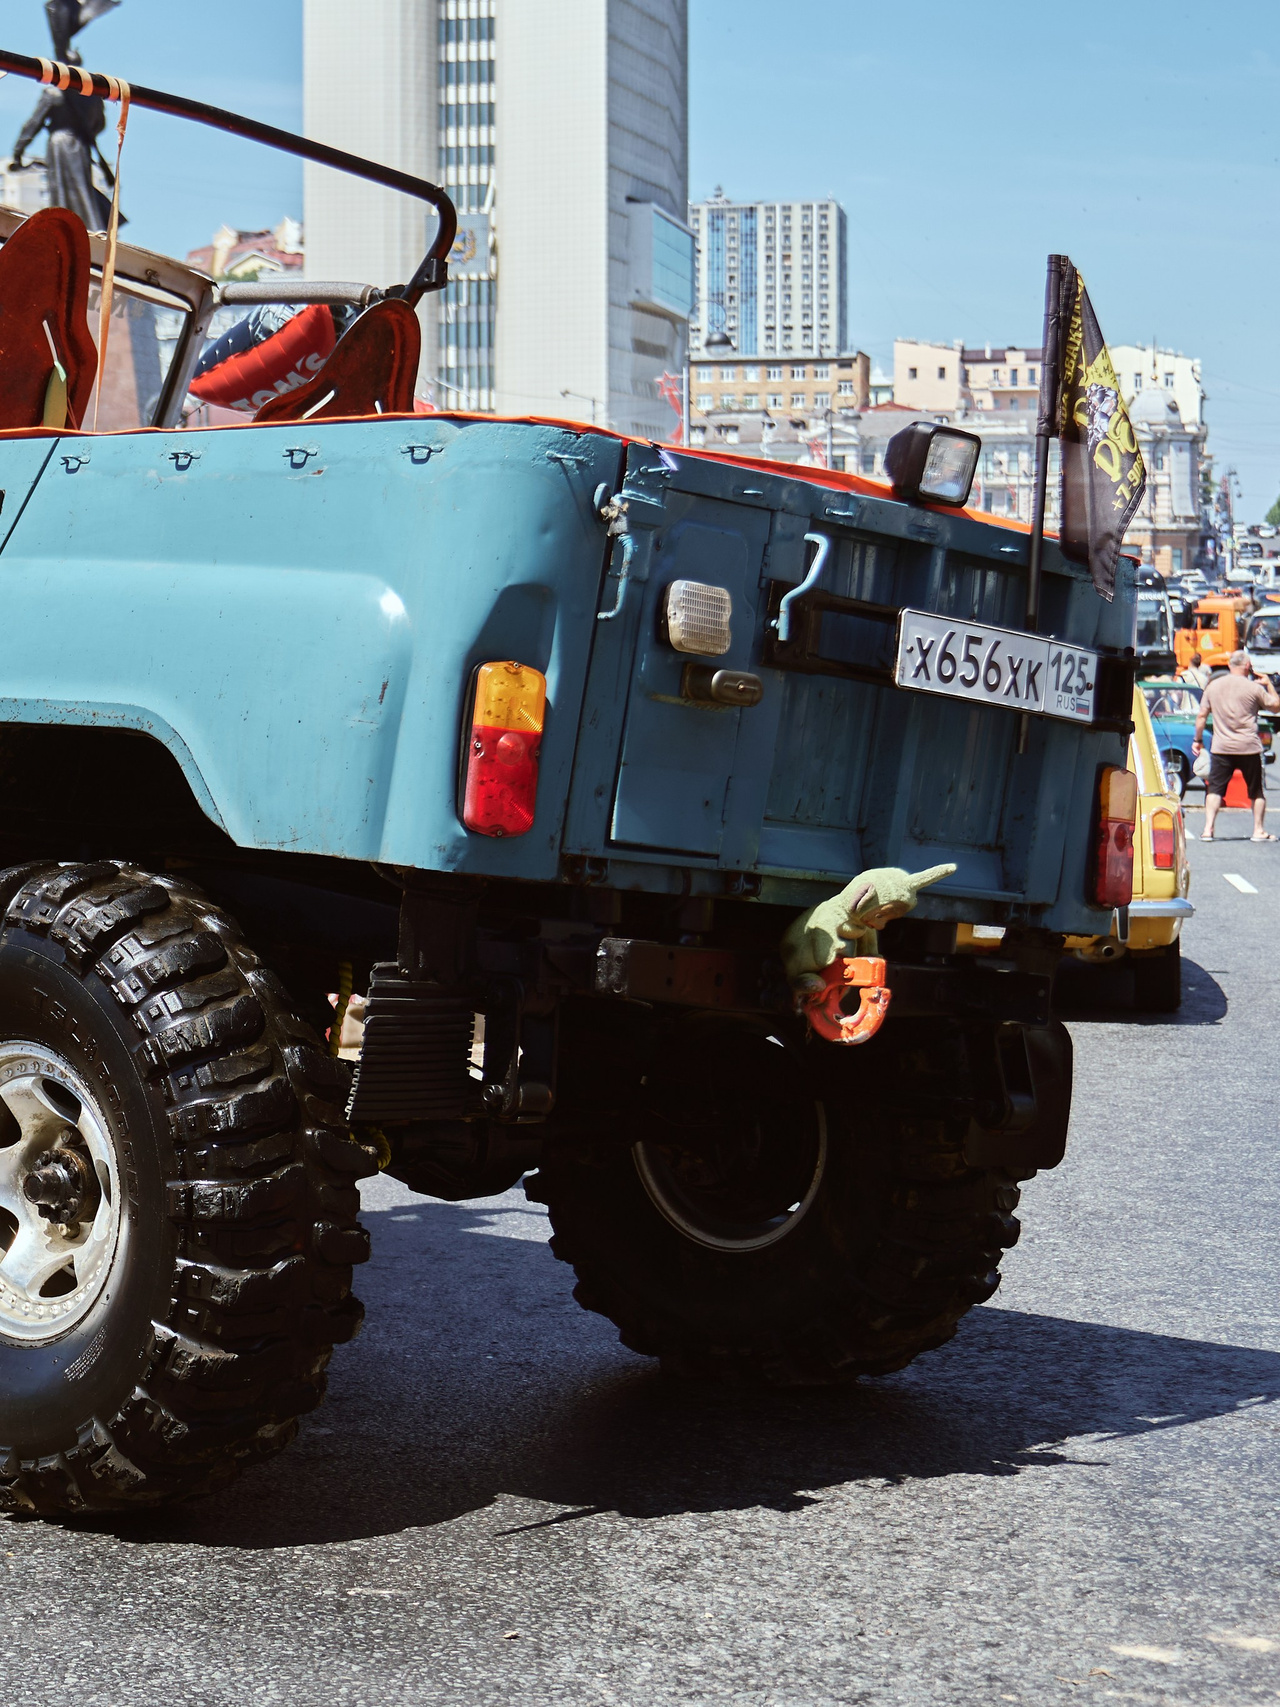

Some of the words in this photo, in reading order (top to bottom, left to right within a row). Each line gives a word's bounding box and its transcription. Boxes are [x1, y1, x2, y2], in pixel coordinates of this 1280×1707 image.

[910, 629, 1043, 702] X656XK
[1051, 650, 1089, 695] 125
[1056, 694, 1076, 712] RUS
